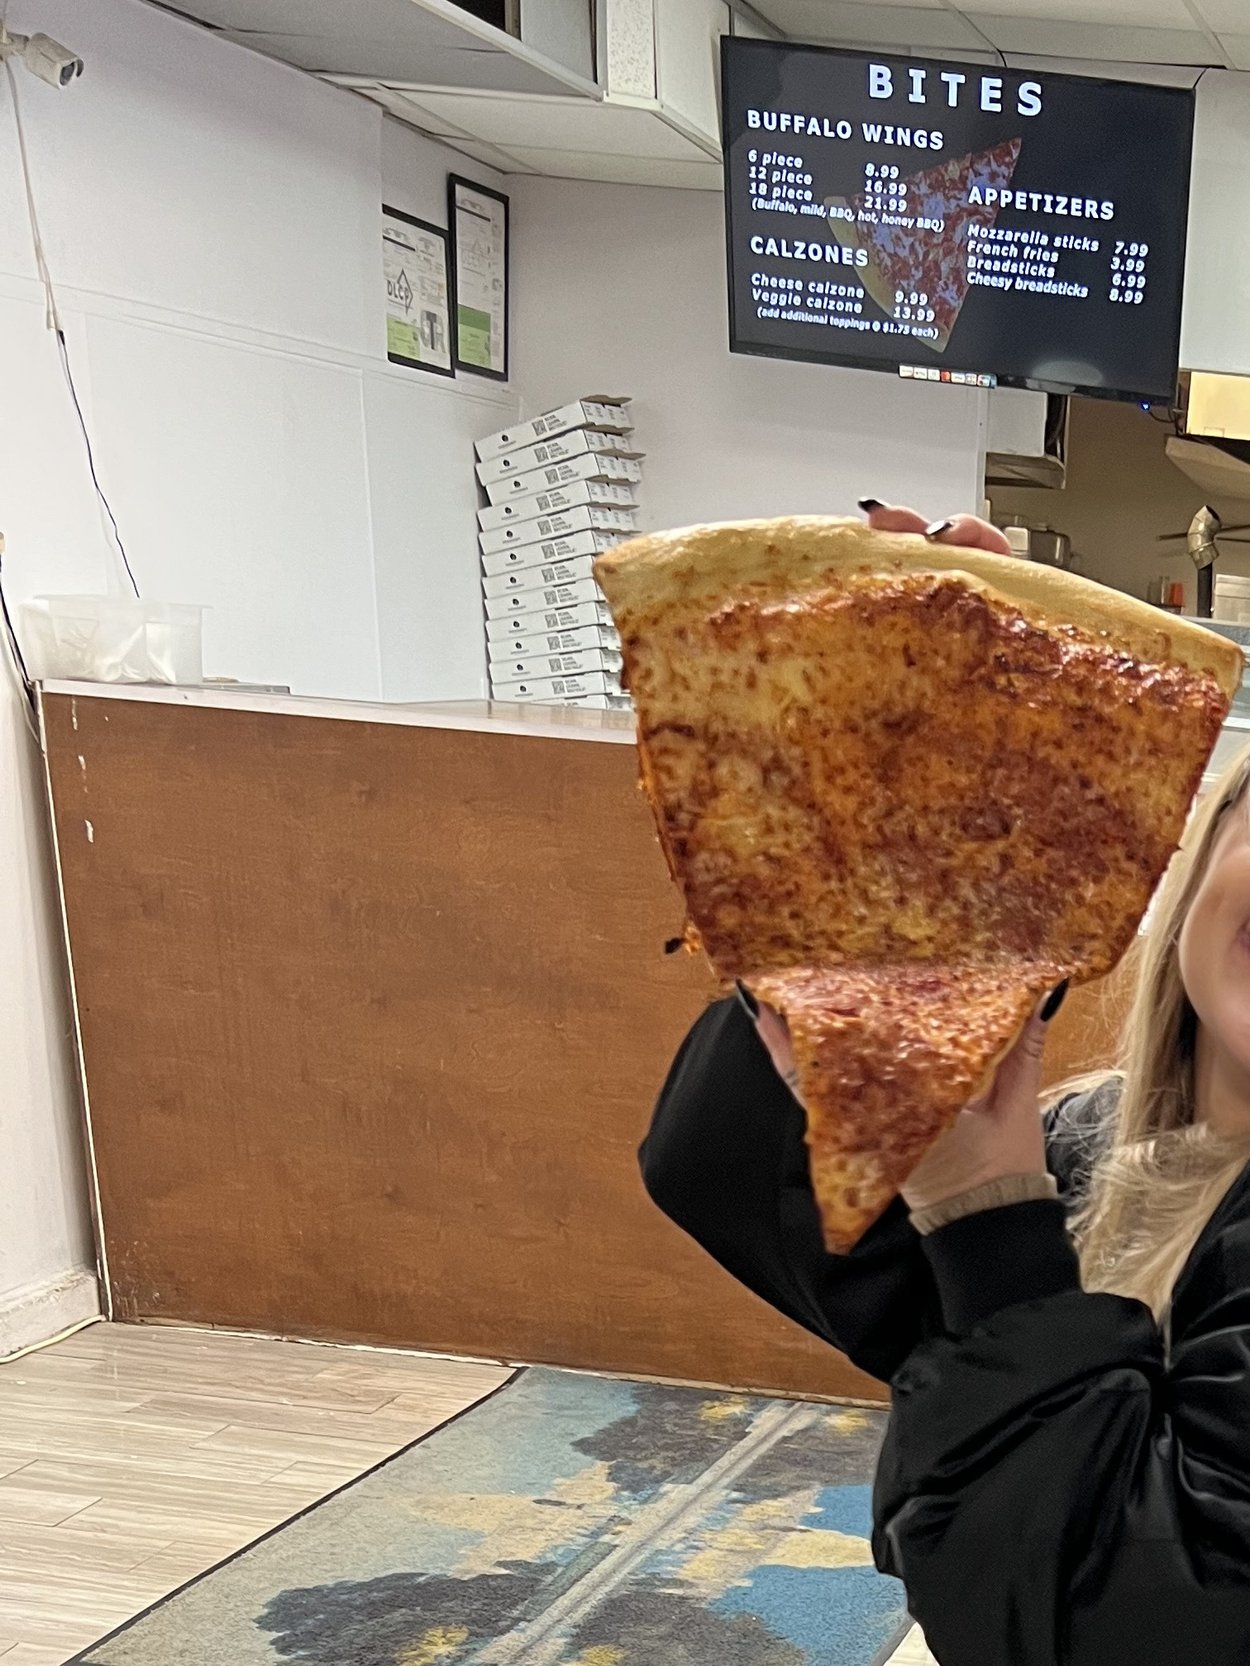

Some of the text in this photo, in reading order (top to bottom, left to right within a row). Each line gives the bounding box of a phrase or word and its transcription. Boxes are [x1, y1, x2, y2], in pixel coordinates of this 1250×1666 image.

[869, 64, 1042, 116] BITES
[747, 109, 944, 150] BUFFALO WINGS
[748, 149, 900, 179] 6 piece 8.99
[749, 166, 907, 196] 12 piece 16.99
[749, 182, 907, 213] 18 piece 21.99
[968, 186, 1115, 221] APPETIZERS
[752, 198, 945, 233] (Buffalo, mild, BBQ, hot, honey BBQ)
[750, 235, 869, 267] CALZONES
[967, 224, 1149, 258] Mozzarella sticks 7.99
[967, 240, 1145, 273] French fries 3.99
[966, 271, 1144, 305] Cheesy breadsticks 8.99
[967, 255, 1147, 289] Breadsticks 6.99
[751, 273, 928, 306] Cheese calzone 9.99
[752, 288, 935, 323] Veggie calzone 13.99
[757, 306, 780, 319] (add
[780, 310, 828, 325] additional
[829, 315, 871, 331] toppings
[911, 327, 939, 340] each)
